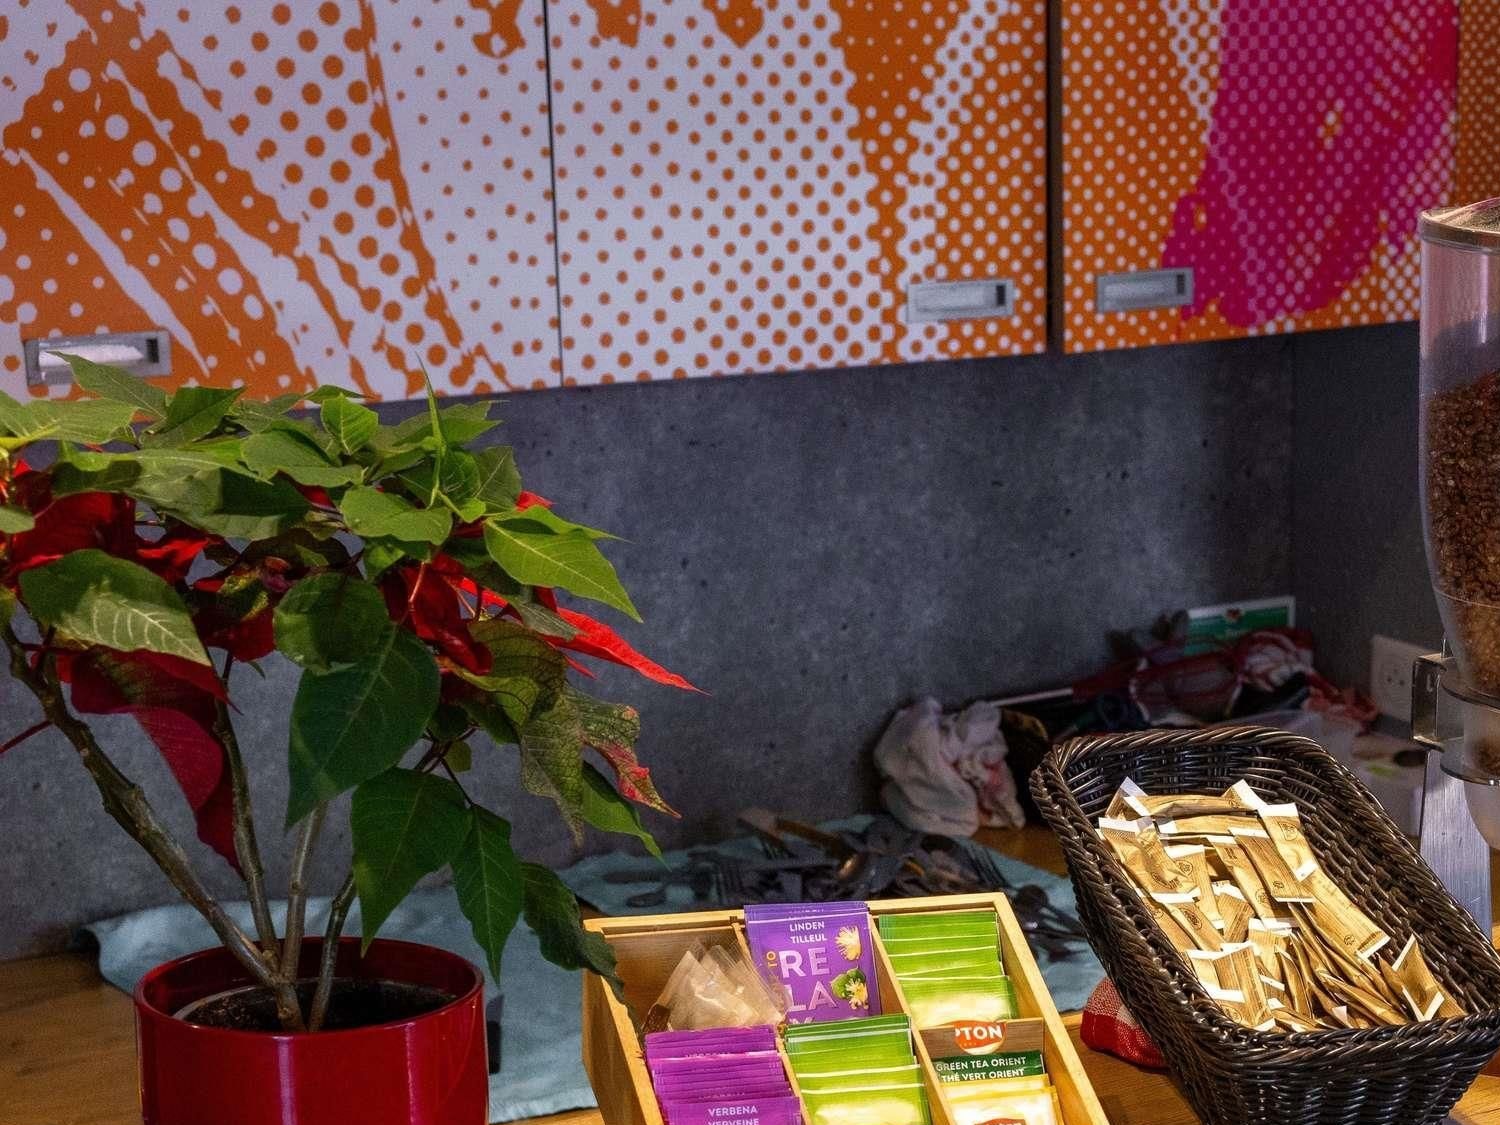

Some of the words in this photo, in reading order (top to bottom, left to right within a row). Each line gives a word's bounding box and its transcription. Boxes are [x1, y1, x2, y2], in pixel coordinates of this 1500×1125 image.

[789, 921, 825, 932] LINDEN
[790, 933, 828, 944] TILLEUL
[936, 1061, 969, 1072] GREEN
[971, 1060, 989, 1070] TEA
[991, 1057, 1027, 1068] ORIENT
[962, 1072, 987, 1082] VERT
[988, 1069, 1025, 1080] ORIENT
[708, 1105, 759, 1117] VERBENA
